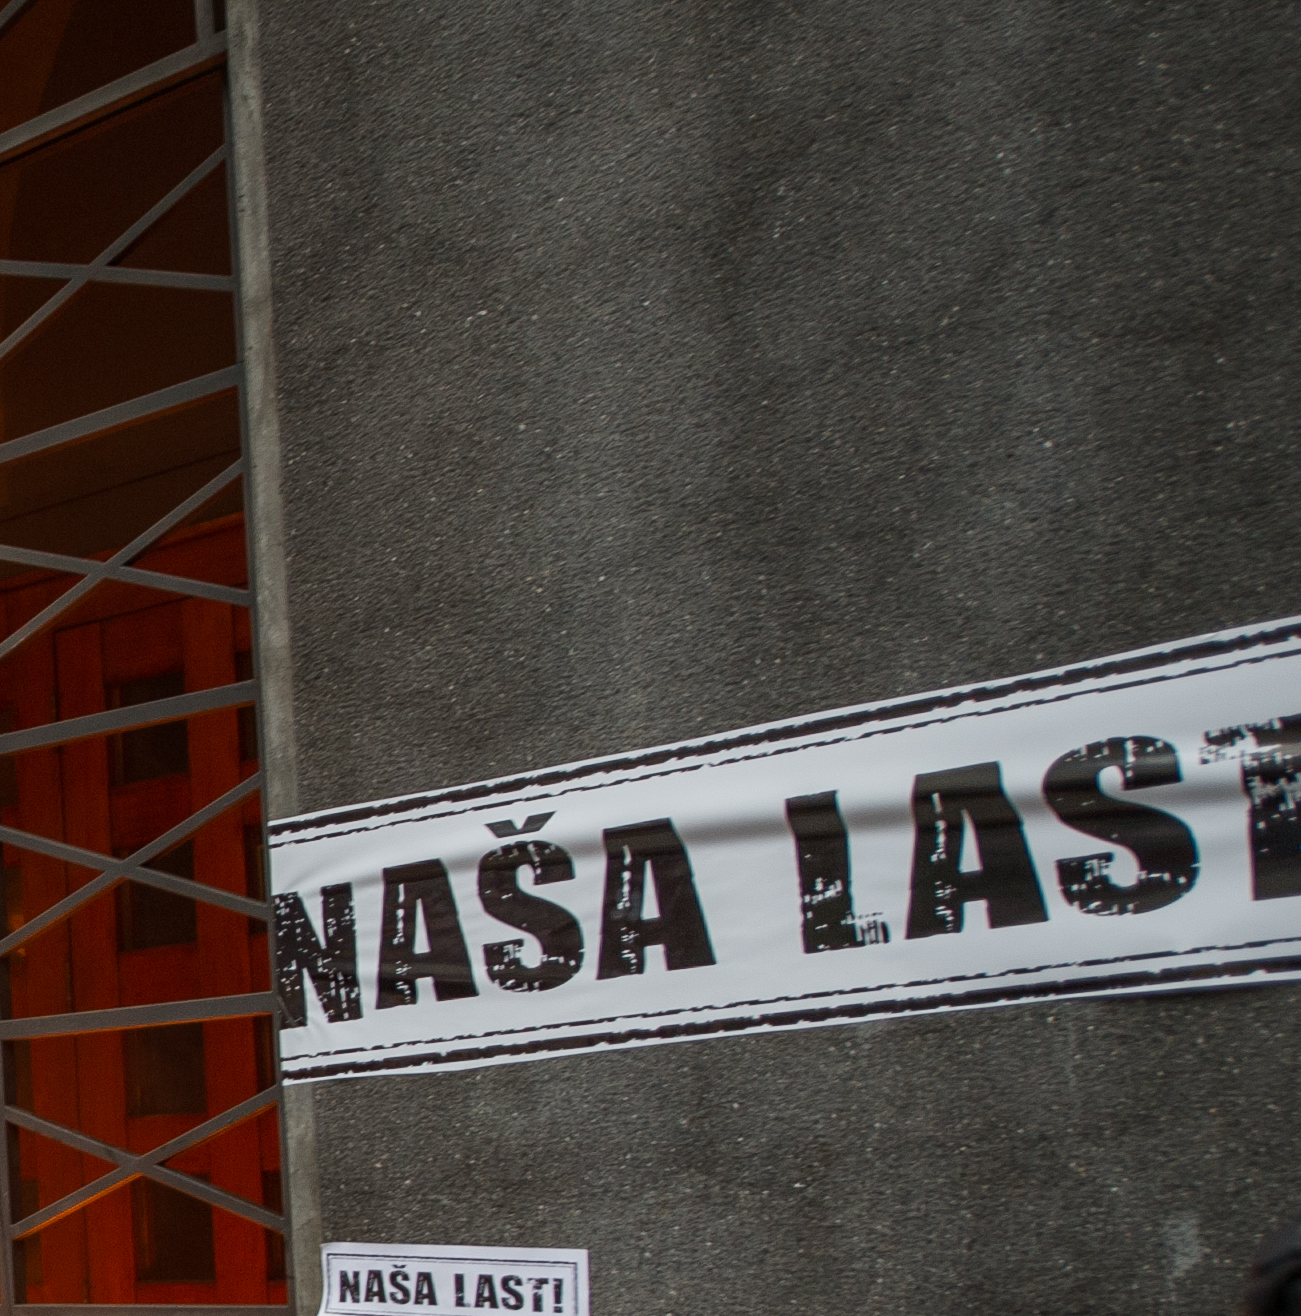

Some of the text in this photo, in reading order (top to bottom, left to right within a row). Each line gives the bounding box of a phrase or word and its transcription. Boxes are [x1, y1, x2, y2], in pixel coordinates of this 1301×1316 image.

[271, 811, 717, 1031] NAŠA
[338, 1264, 564, 1313] NAŠA LAST!
